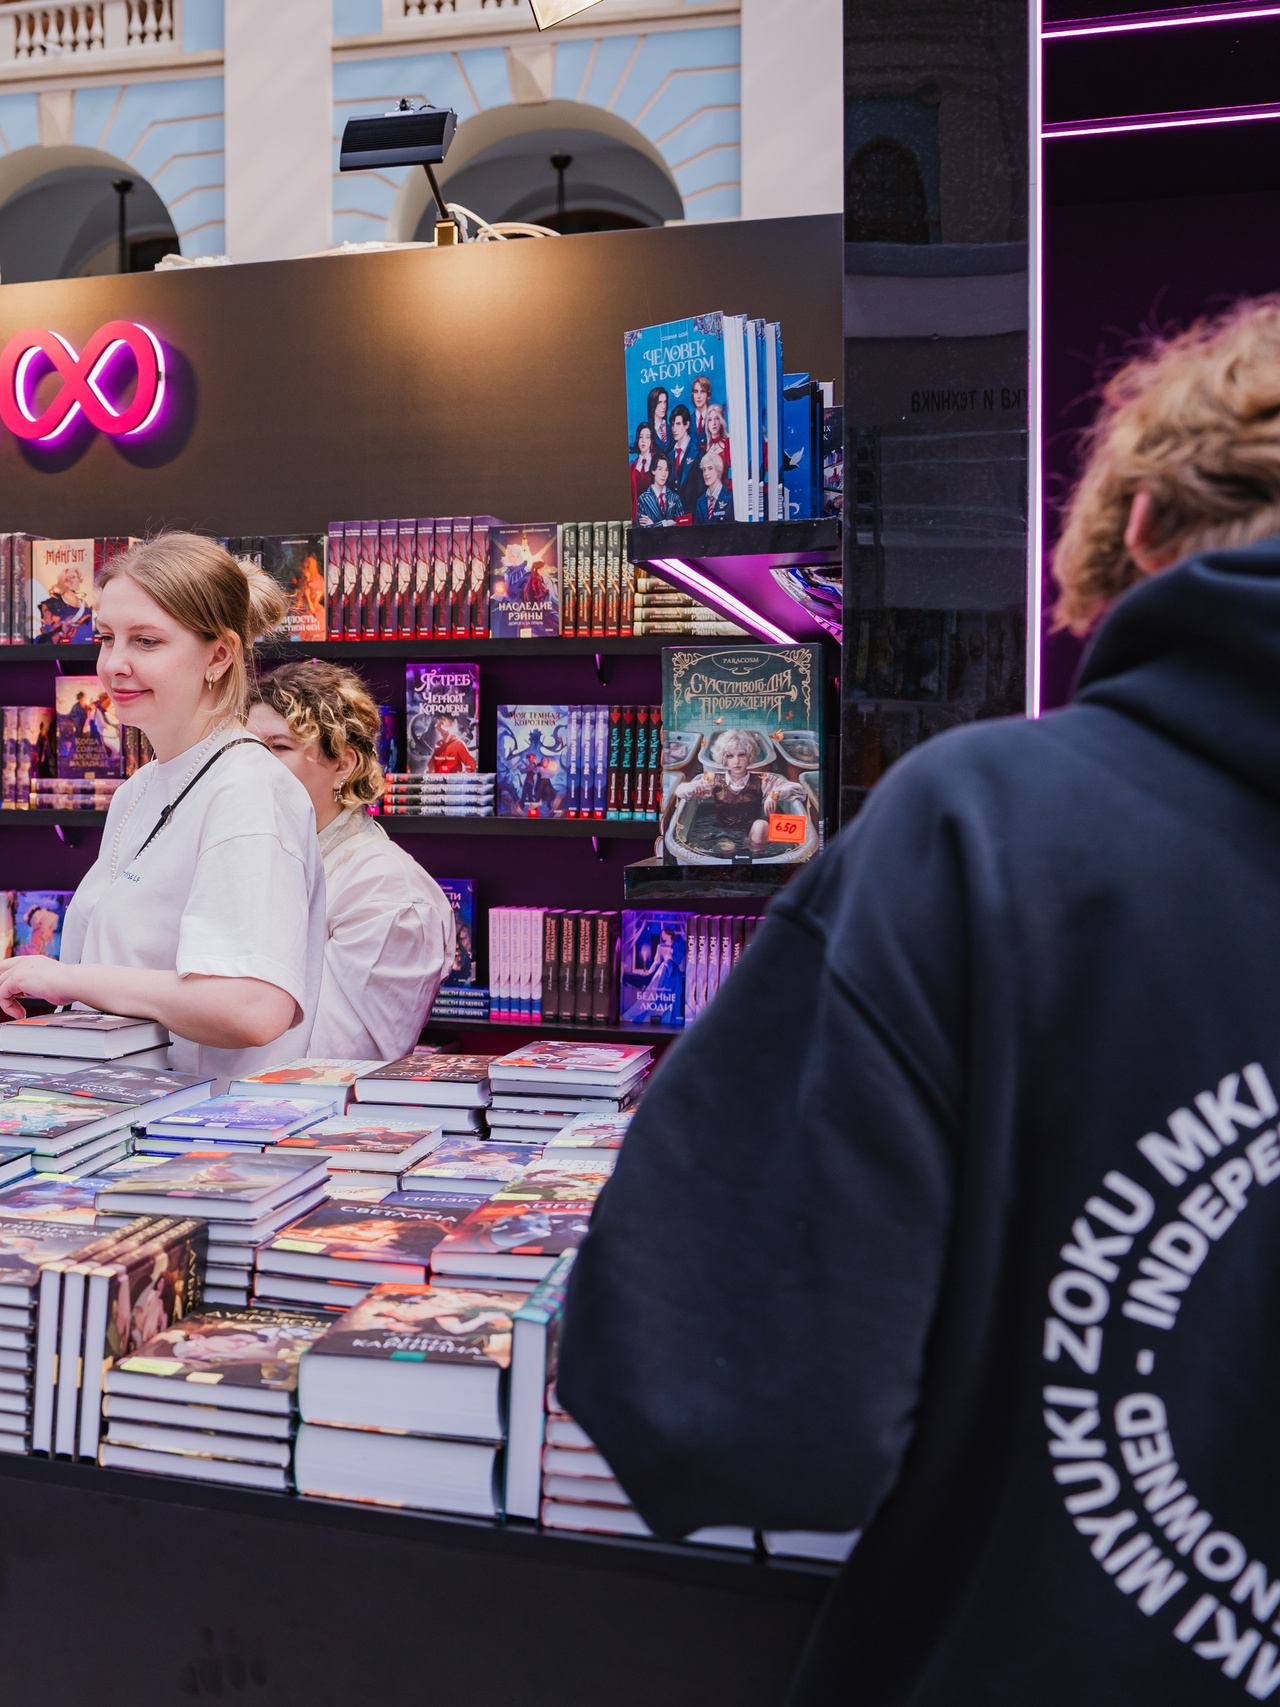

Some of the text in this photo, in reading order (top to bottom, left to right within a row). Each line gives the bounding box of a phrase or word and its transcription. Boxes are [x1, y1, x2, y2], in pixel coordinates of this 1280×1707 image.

[642, 338, 707, 366] ЧЕЛОВЕК
[658, 355, 715, 380] БОРТОМ
[498, 601, 553, 612] НАСЛЕДИЕ
[508, 611, 543, 621] РЭЙНЫ
[722, 656, 759, 664] PARACOSM
[415, 669, 471, 692] ЯСТРЕБ
[419, 702, 469, 717] КОРОЛЕВЫ
[509, 711, 561, 720] МОЯ ТЕМНАЯ
[698, 694, 785, 723] ПРОБУЖДЕНИЯ
[514, 719, 557, 727] КОРОЛЕВА
[75, 738, 99, 746] КОГДА
[775, 821, 797, 834] 650
[636, 991, 677, 1002] БЕДНЫЕ
[639, 1002, 673, 1012] ЛЮДИ
[1135, 1061, 1279, 1187] MKI
[339, 1205, 458, 1223] СВЕТЛАНА
[1120, 1126, 1280, 1331] INDEPE
[1042, 1169, 1156, 1375] ZOKU
[1042, 1384, 1189, 1617] MIYUKI
